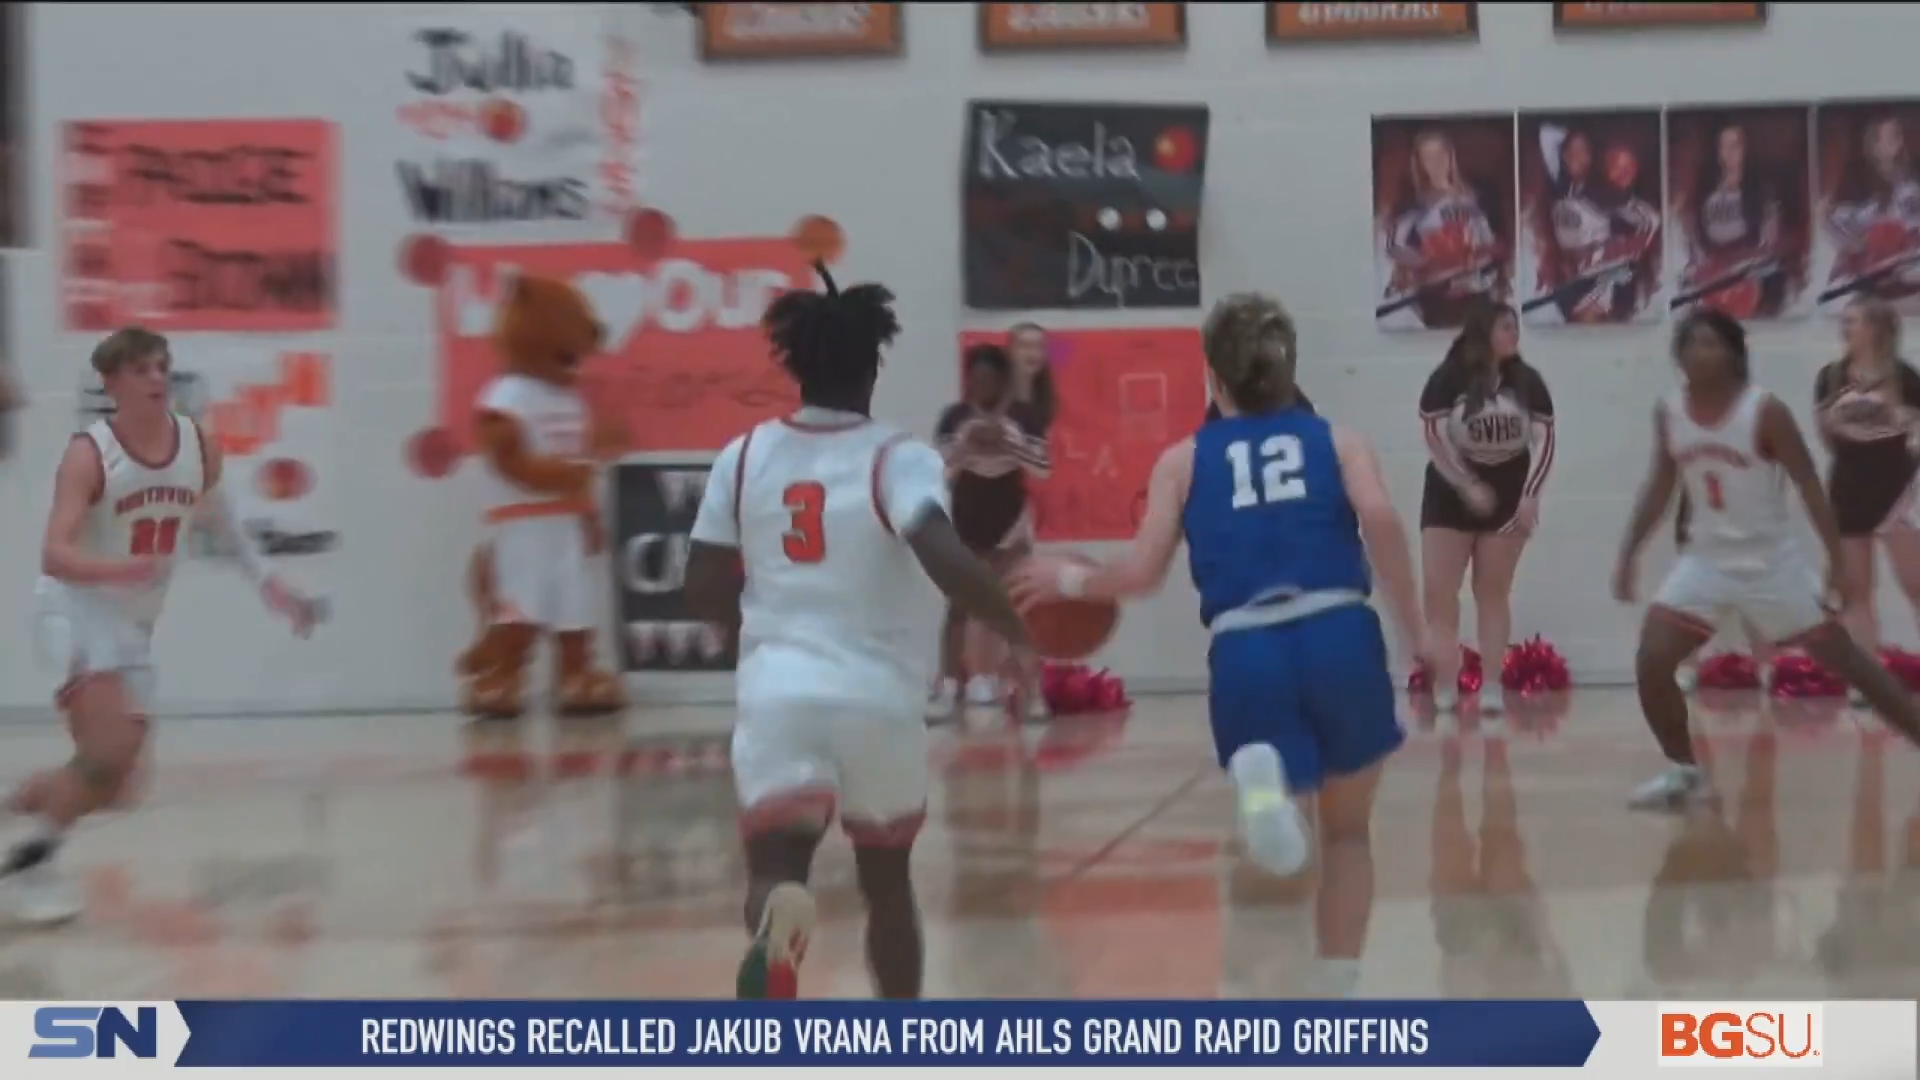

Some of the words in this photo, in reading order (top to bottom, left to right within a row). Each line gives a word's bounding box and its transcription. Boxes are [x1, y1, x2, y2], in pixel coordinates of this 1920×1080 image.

[979, 109, 1141, 181] Kaela
[1467, 412, 1522, 444] SVHS
[1225, 433, 1307, 510] 12
[1703, 470, 1727, 514] 1
[781, 480, 827, 564] 3
